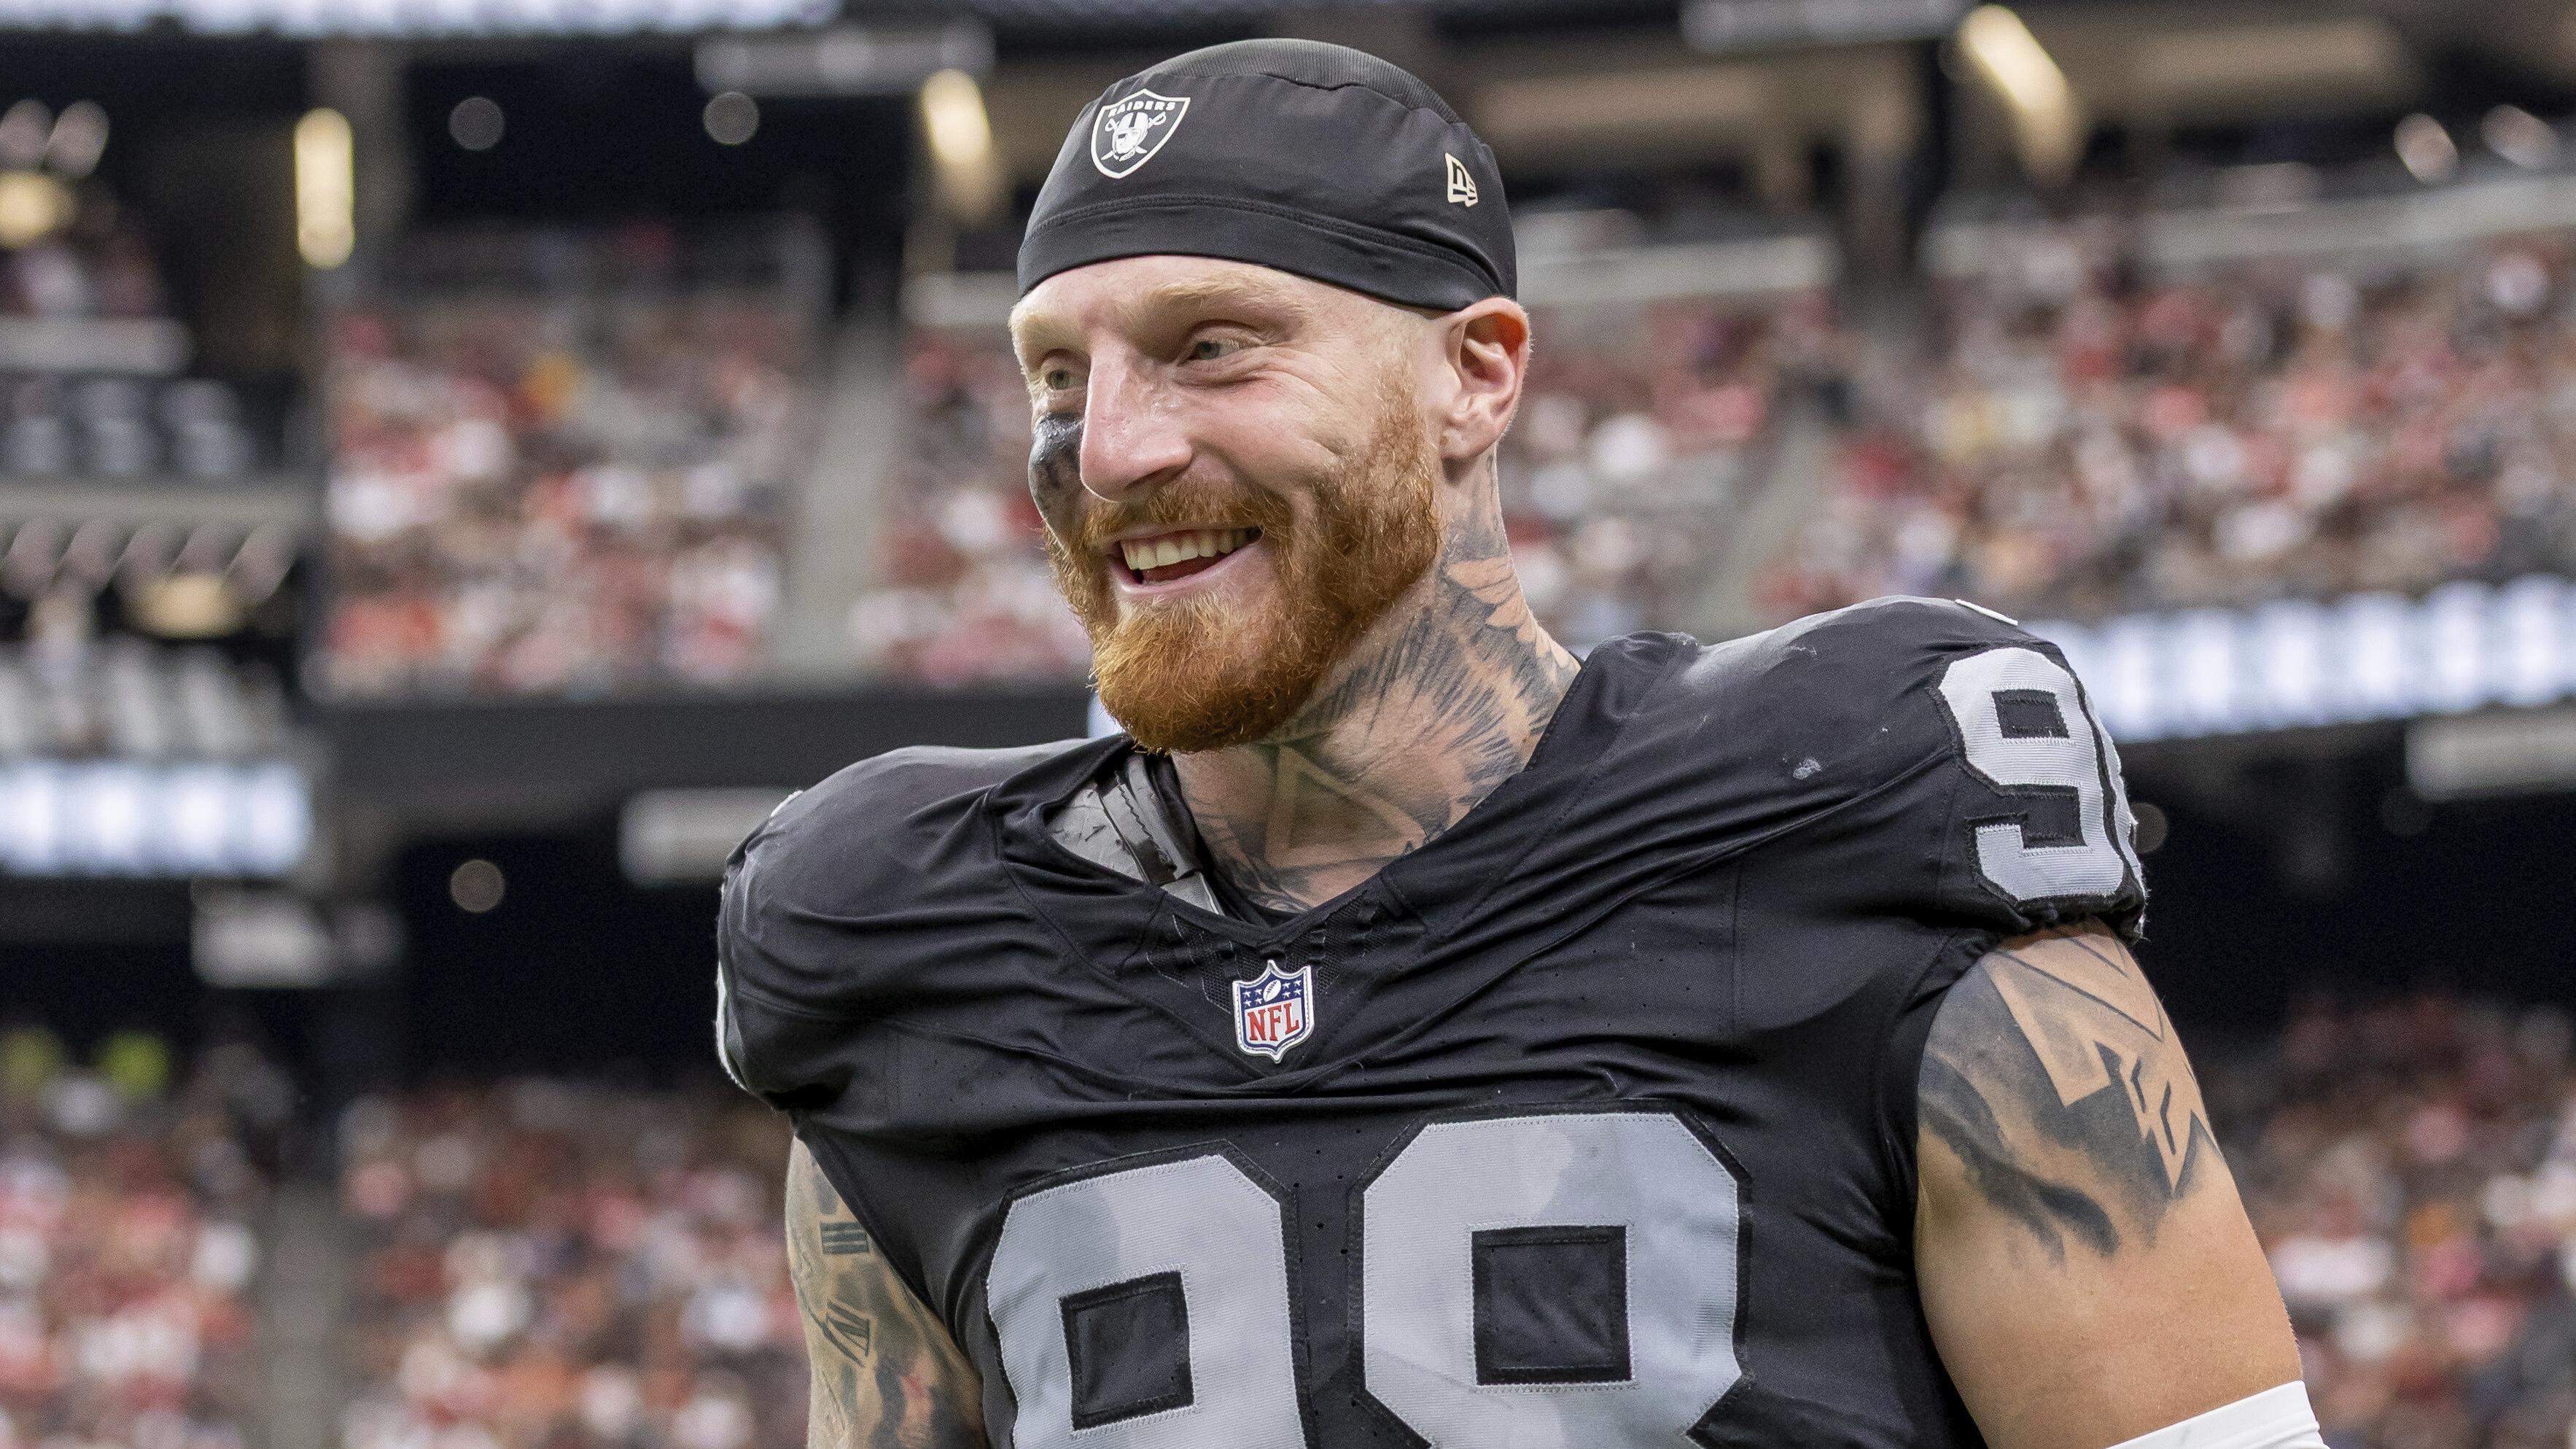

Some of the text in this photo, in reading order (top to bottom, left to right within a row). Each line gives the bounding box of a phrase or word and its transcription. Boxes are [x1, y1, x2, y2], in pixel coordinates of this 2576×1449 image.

[1108, 101, 1176, 117] RAIDERS
[1938, 647, 2147, 907] 9
[1248, 1003, 1300, 1041] NFL
